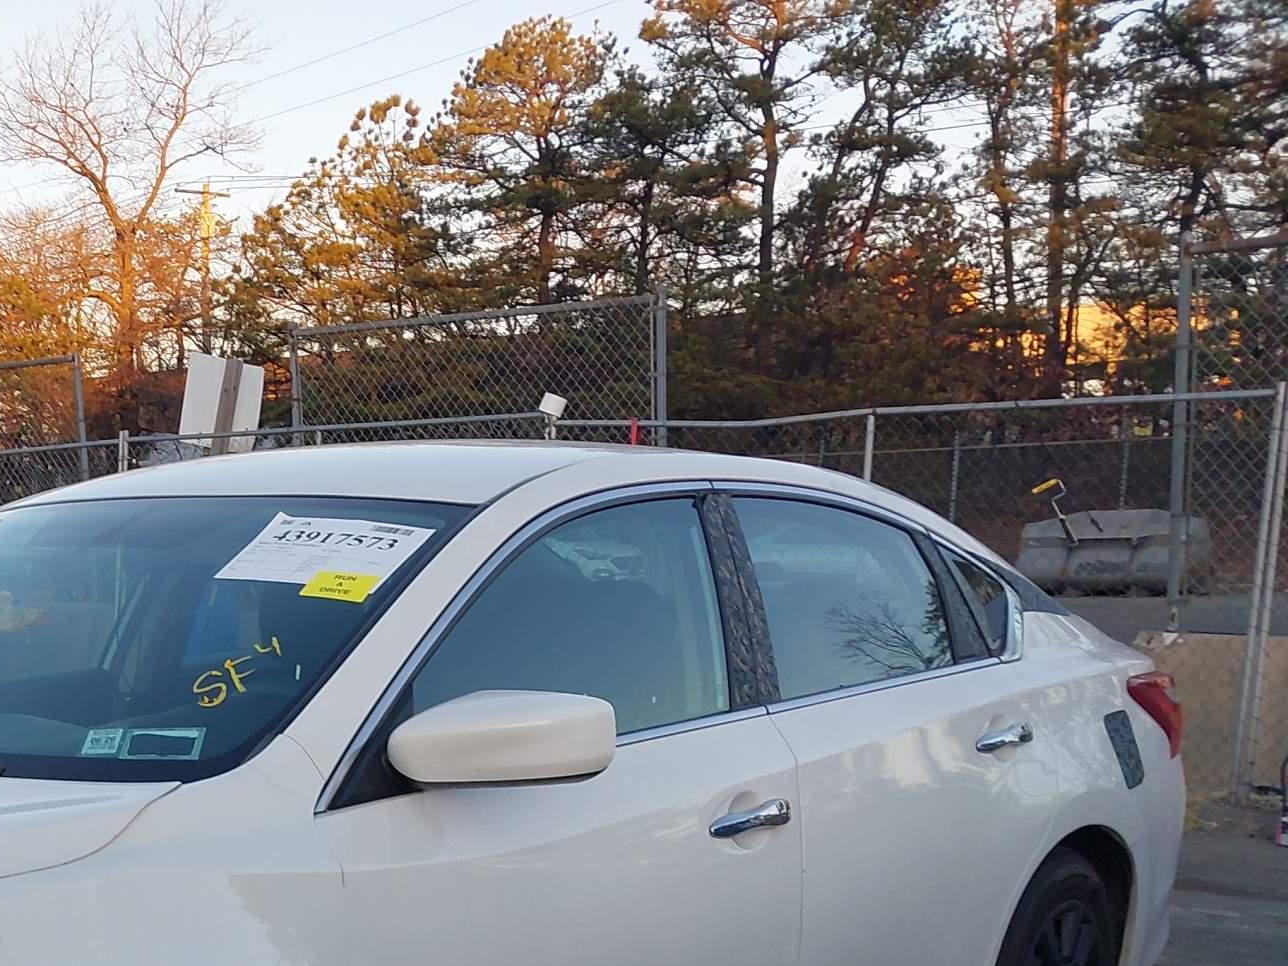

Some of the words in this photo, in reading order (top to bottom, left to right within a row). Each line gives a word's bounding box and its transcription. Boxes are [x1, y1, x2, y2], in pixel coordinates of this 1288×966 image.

[272, 529, 399, 551] 43917573
[333, 574, 358, 582] RUN
[318, 586, 352, 595] DRIVE
